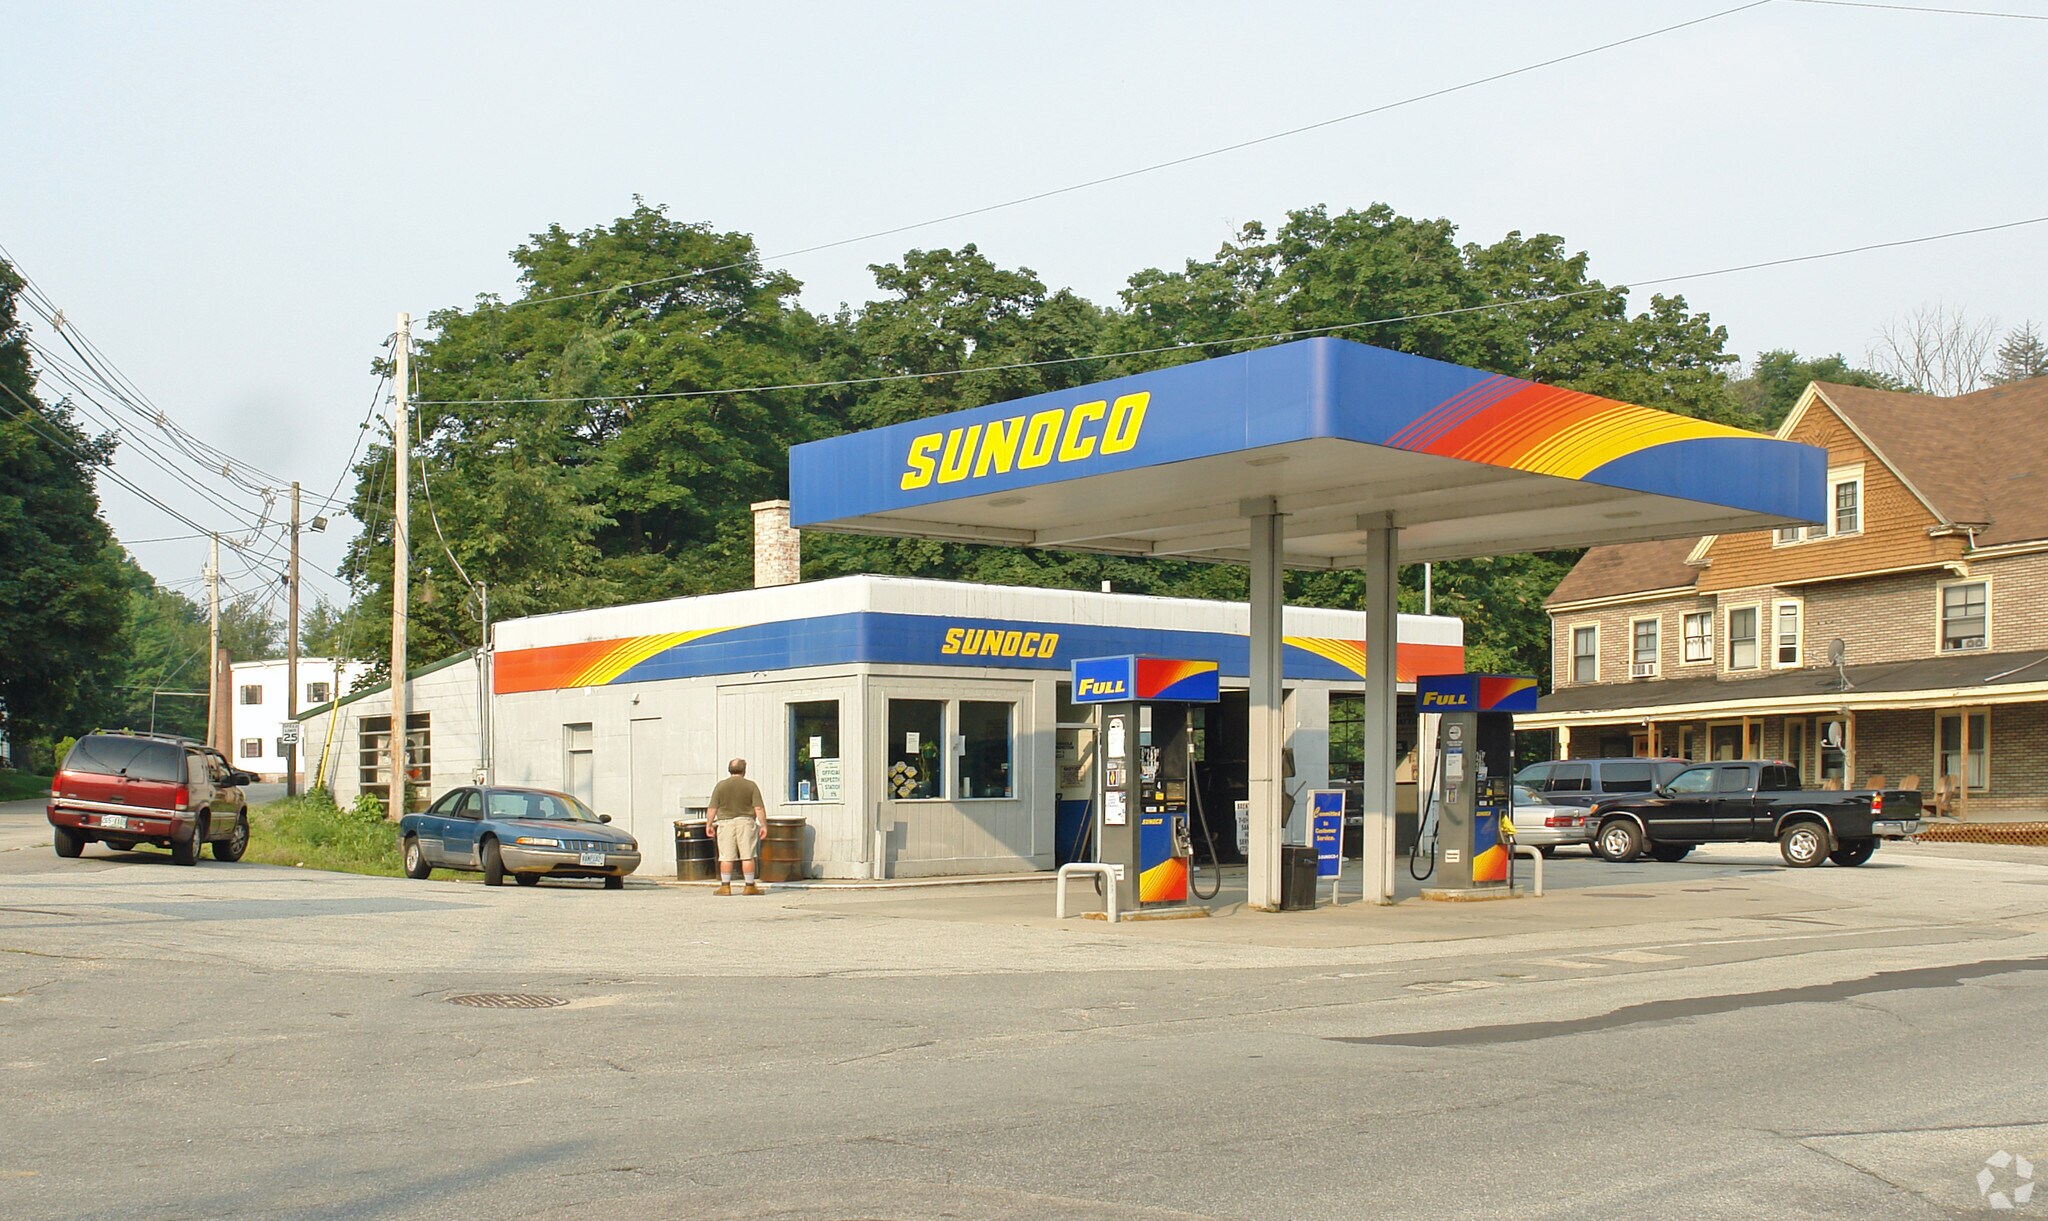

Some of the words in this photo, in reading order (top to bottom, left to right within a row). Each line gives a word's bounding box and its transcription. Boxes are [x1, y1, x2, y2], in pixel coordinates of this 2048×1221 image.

[900, 391, 1151, 490] SUNOCO
[941, 627, 1059, 659] SUNOCO
[283, 733, 298, 742] 25
[1313, 806, 1341, 819] Committed
